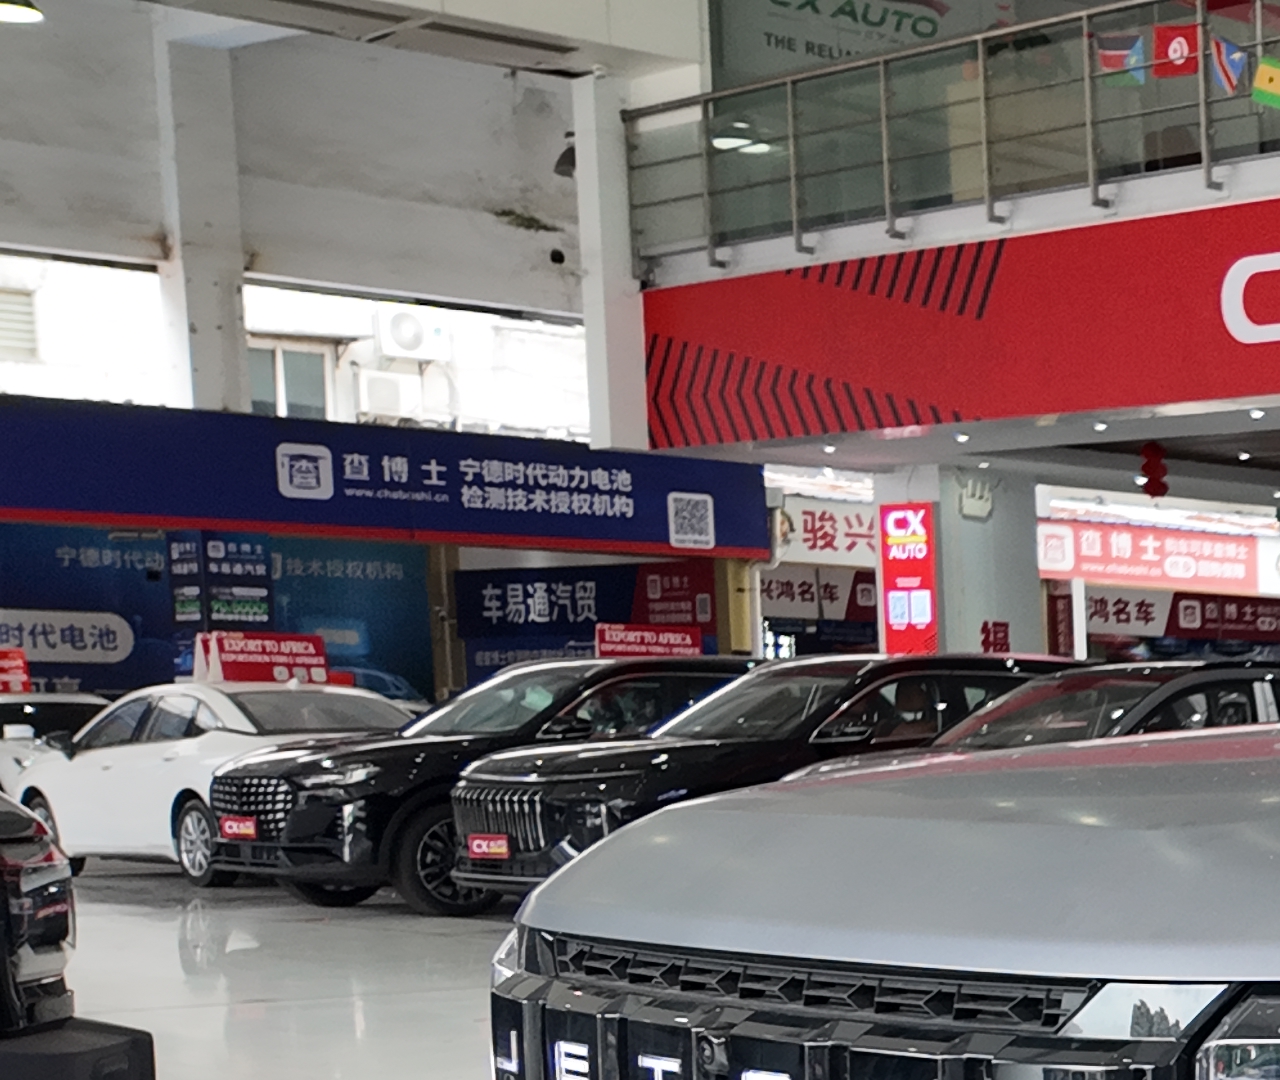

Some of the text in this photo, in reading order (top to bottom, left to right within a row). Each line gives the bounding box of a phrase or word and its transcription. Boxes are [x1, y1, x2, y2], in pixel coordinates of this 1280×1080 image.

[830, 0, 938, 38] AUTO
[763, 31, 798, 53] THE
[458, 458, 633, 493] 宁德时代动力电池
[460, 484, 635, 520] 检测技术授权机构
[886, 509, 926, 537] CX
[888, 543, 928, 560] AUTO
[481, 580, 599, 625] 车易通汽贸
[0, 621, 119, 652] 时代电池
[222, 638, 263, 652] EXPORT
[264, 639, 279, 653] TO
[605, 628, 641, 643] EXPORT
[642, 630, 658, 644] TO
